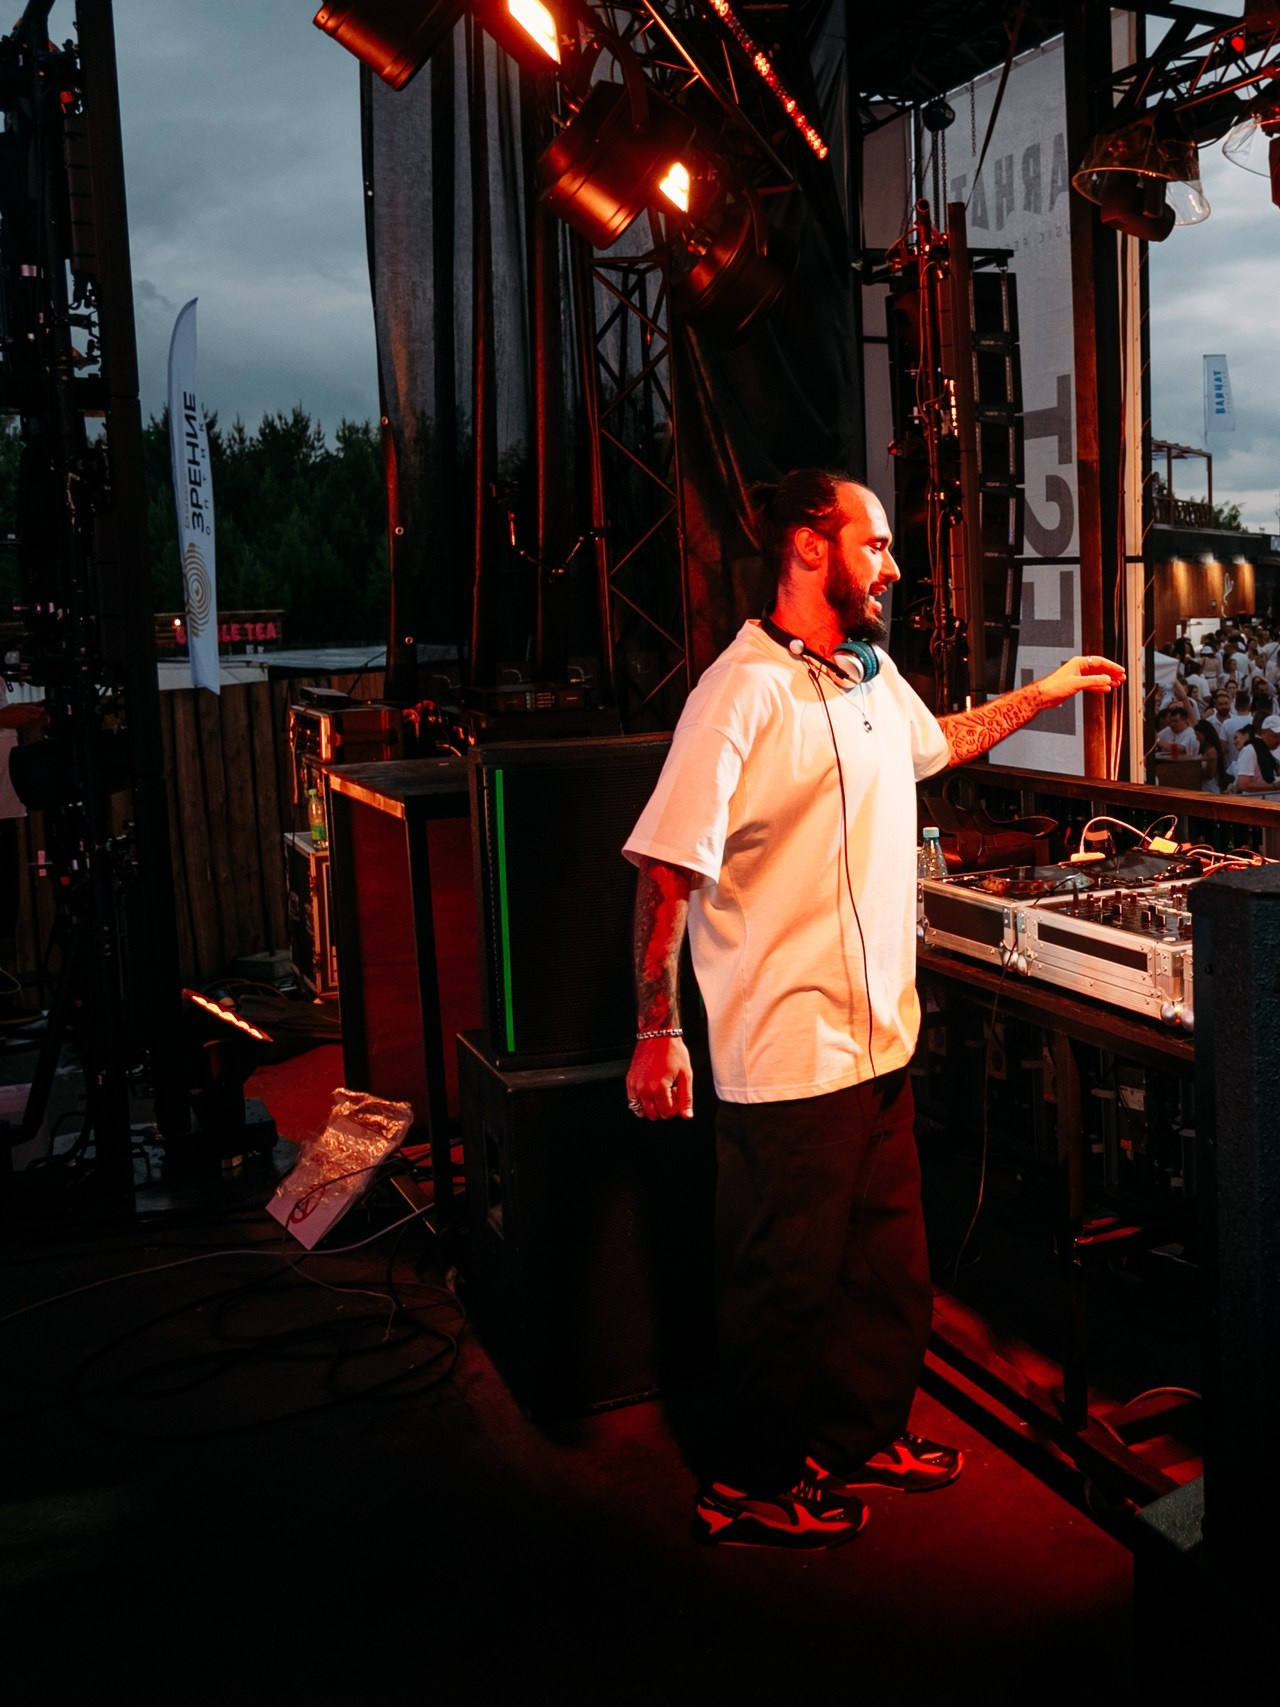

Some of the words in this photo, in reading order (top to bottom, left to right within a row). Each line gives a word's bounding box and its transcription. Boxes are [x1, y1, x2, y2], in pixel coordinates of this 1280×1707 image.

[183, 391, 205, 534] ЗРЕНИЕ
[198, 423, 212, 536] ОПТИК
[243, 622, 276, 641] TEA
